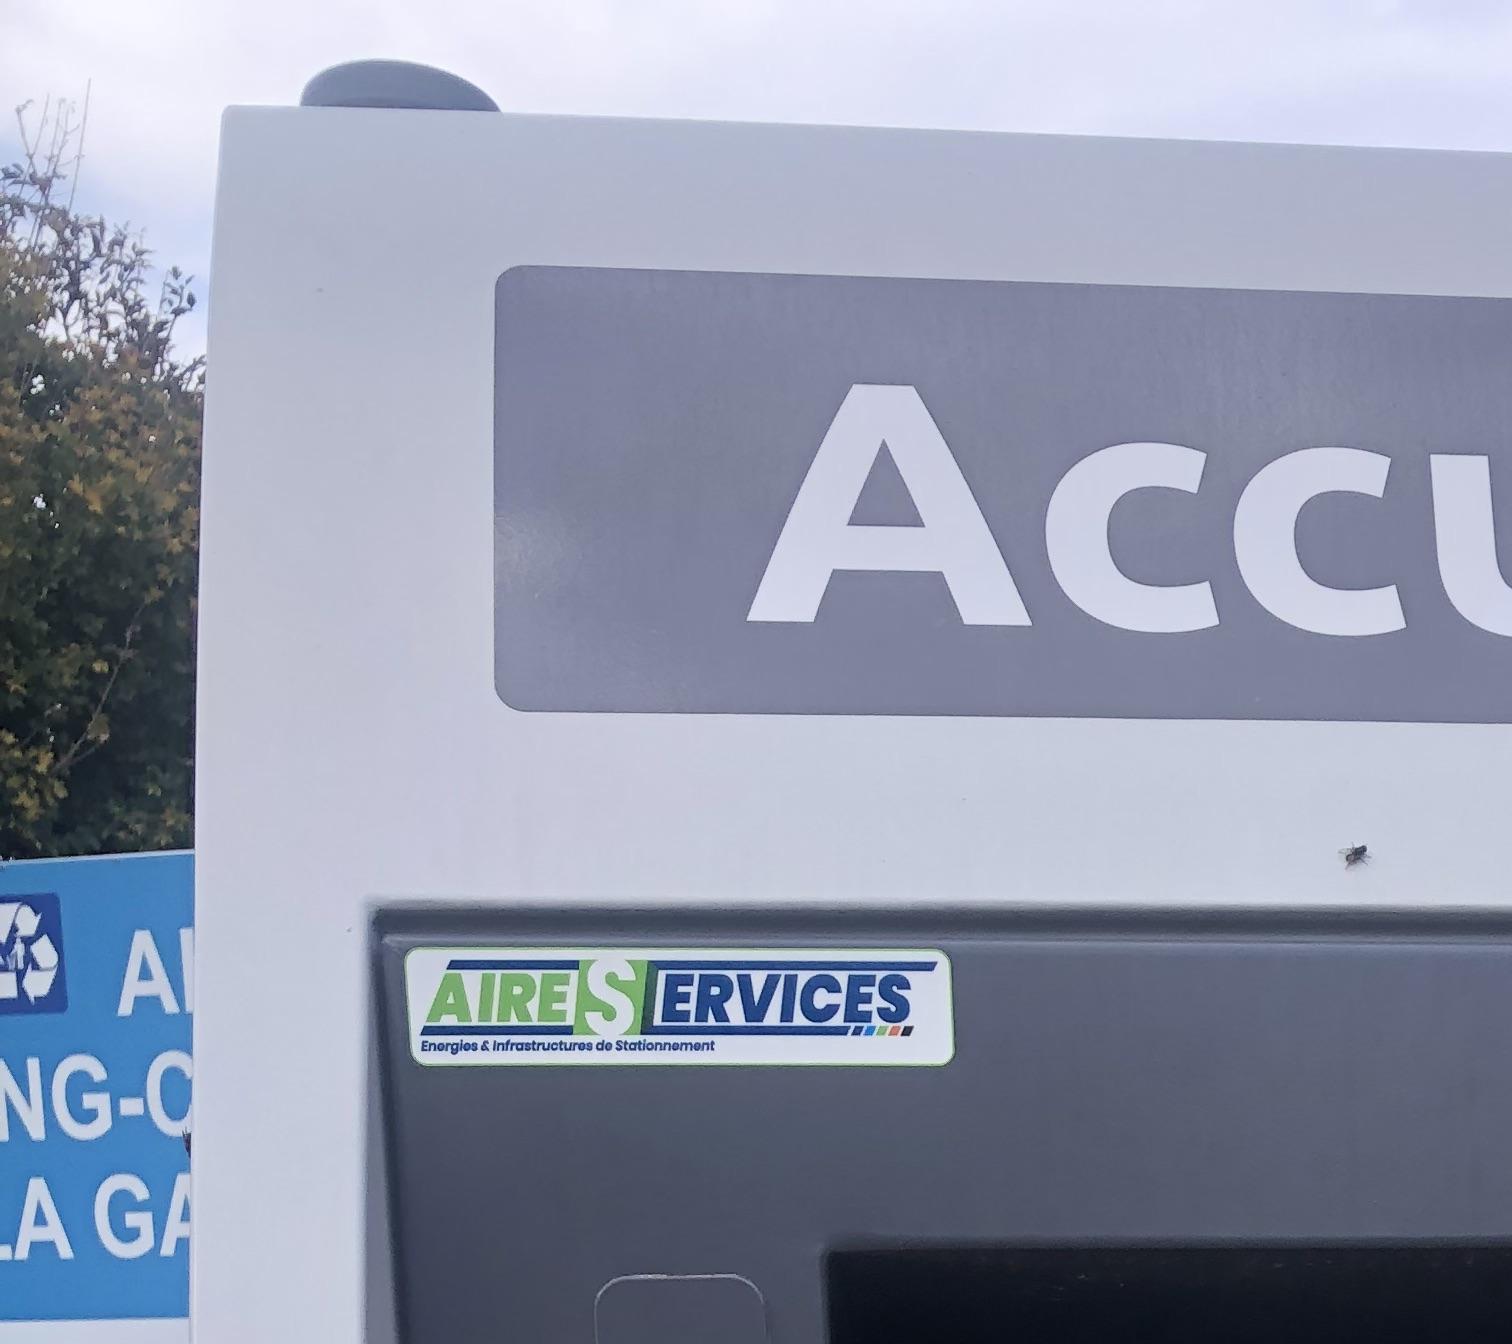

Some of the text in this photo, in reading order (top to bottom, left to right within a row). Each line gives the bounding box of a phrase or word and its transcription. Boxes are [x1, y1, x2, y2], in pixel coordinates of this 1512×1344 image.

[421, 1039, 715, 1055] Energies & Infrastructures de Stationnement
